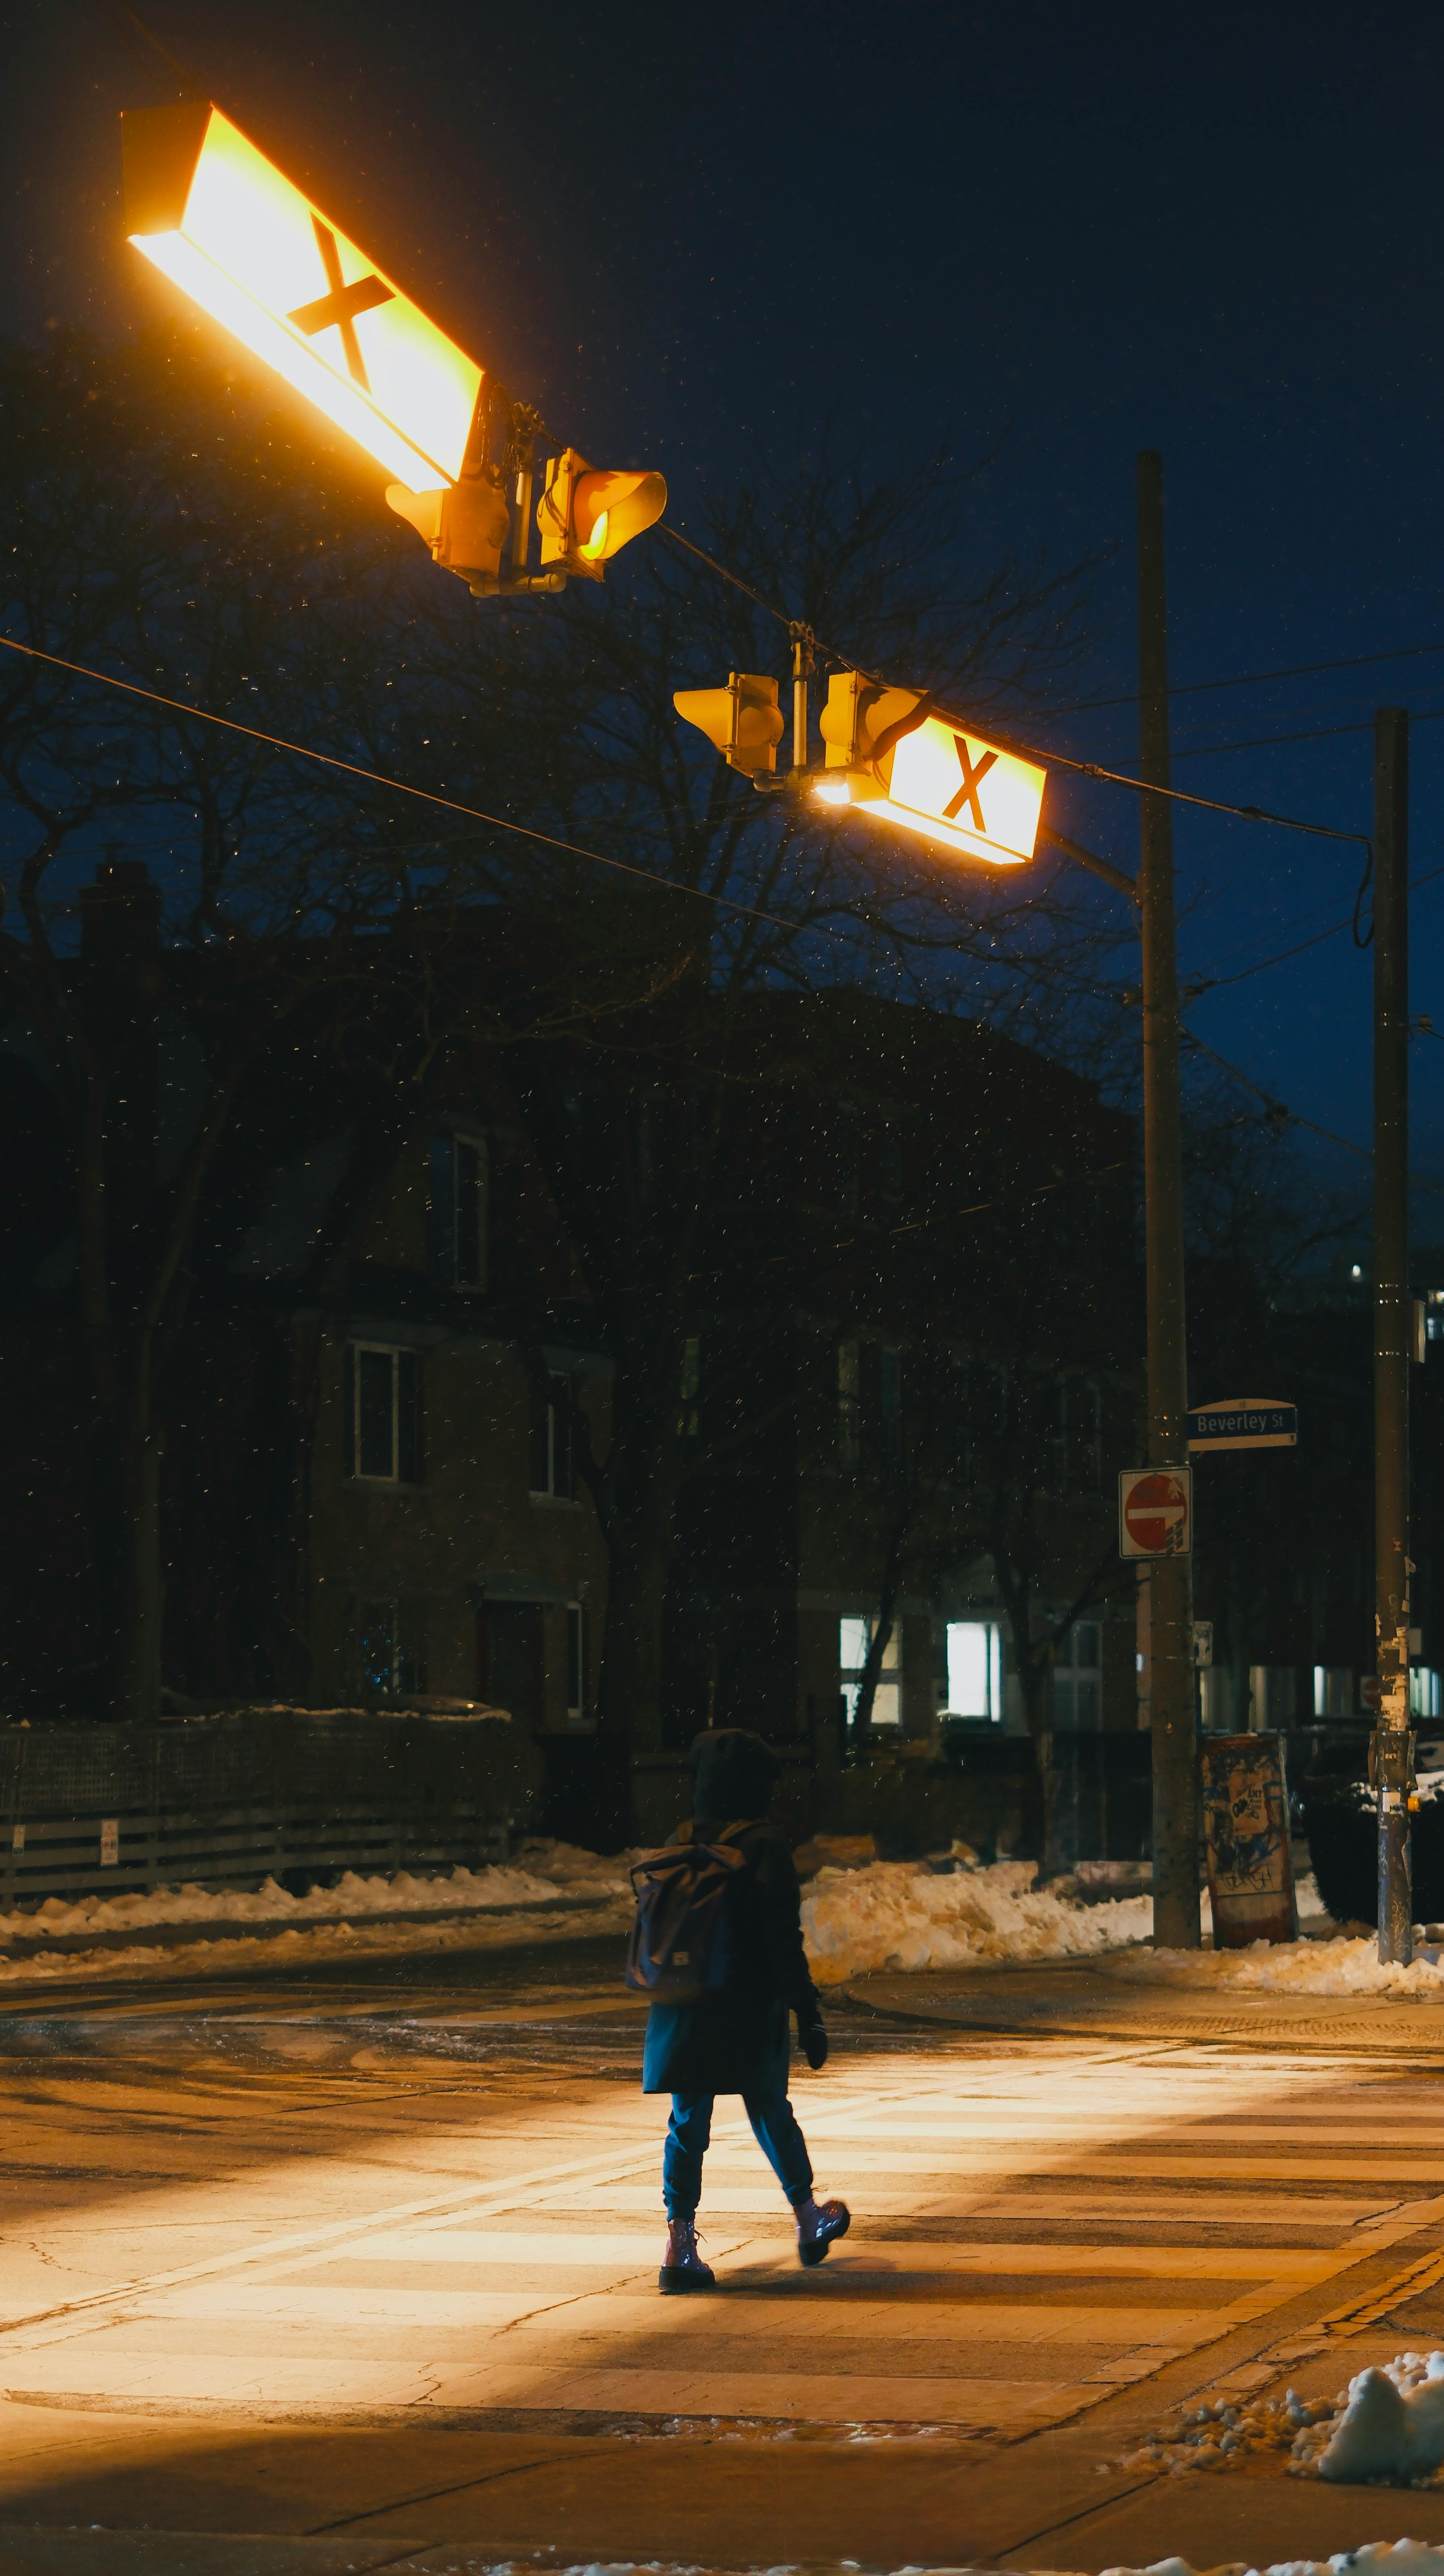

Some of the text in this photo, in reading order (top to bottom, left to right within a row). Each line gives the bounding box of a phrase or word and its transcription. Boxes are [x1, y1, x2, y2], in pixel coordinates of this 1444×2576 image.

[942, 734, 999, 833] X
[1198, 1413, 1283, 1432] Beverley St
